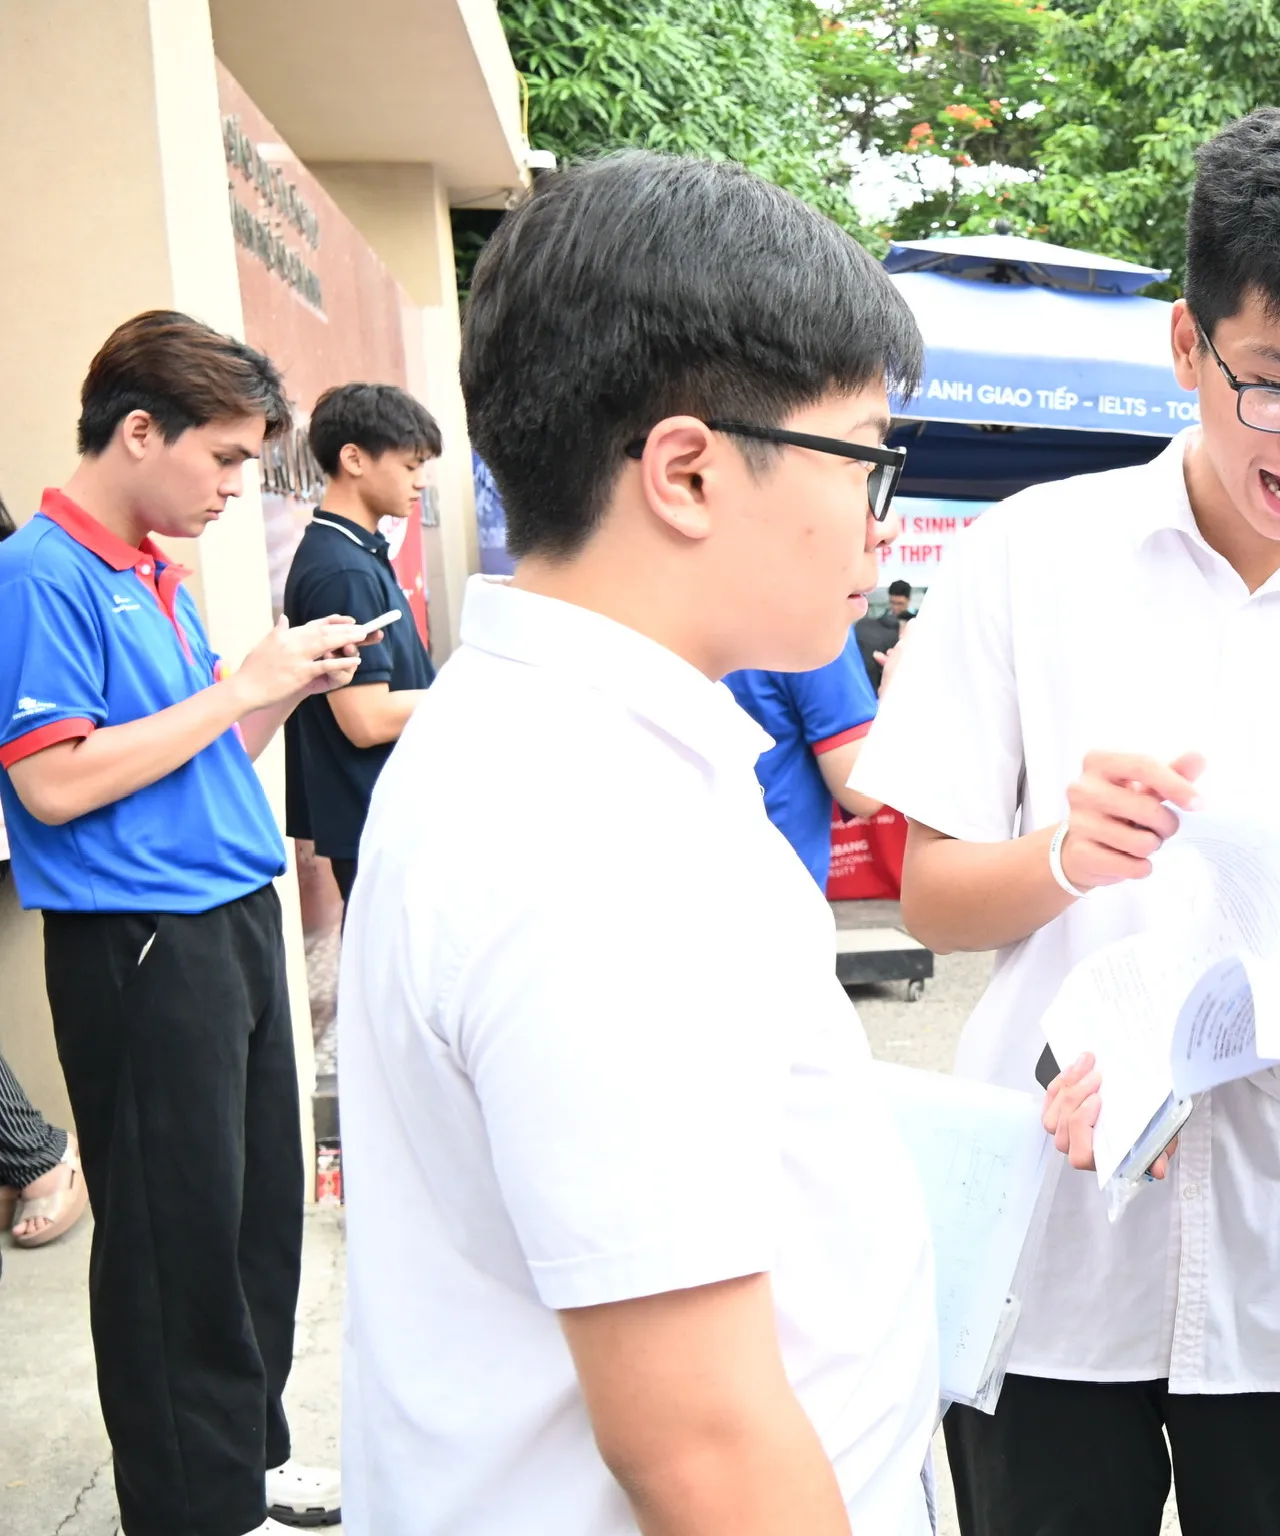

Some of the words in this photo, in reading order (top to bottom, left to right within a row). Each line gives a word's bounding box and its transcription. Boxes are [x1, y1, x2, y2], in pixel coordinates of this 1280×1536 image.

[927, 379, 973, 402] ANH
[977, 385, 1032, 408] GIAO
[1036, 386, 1079, 411] TIẾP
[1098, 396, 1147, 417] IELTS
[913, 517, 956, 533] SINH
[900, 545, 942, 563] THPT
